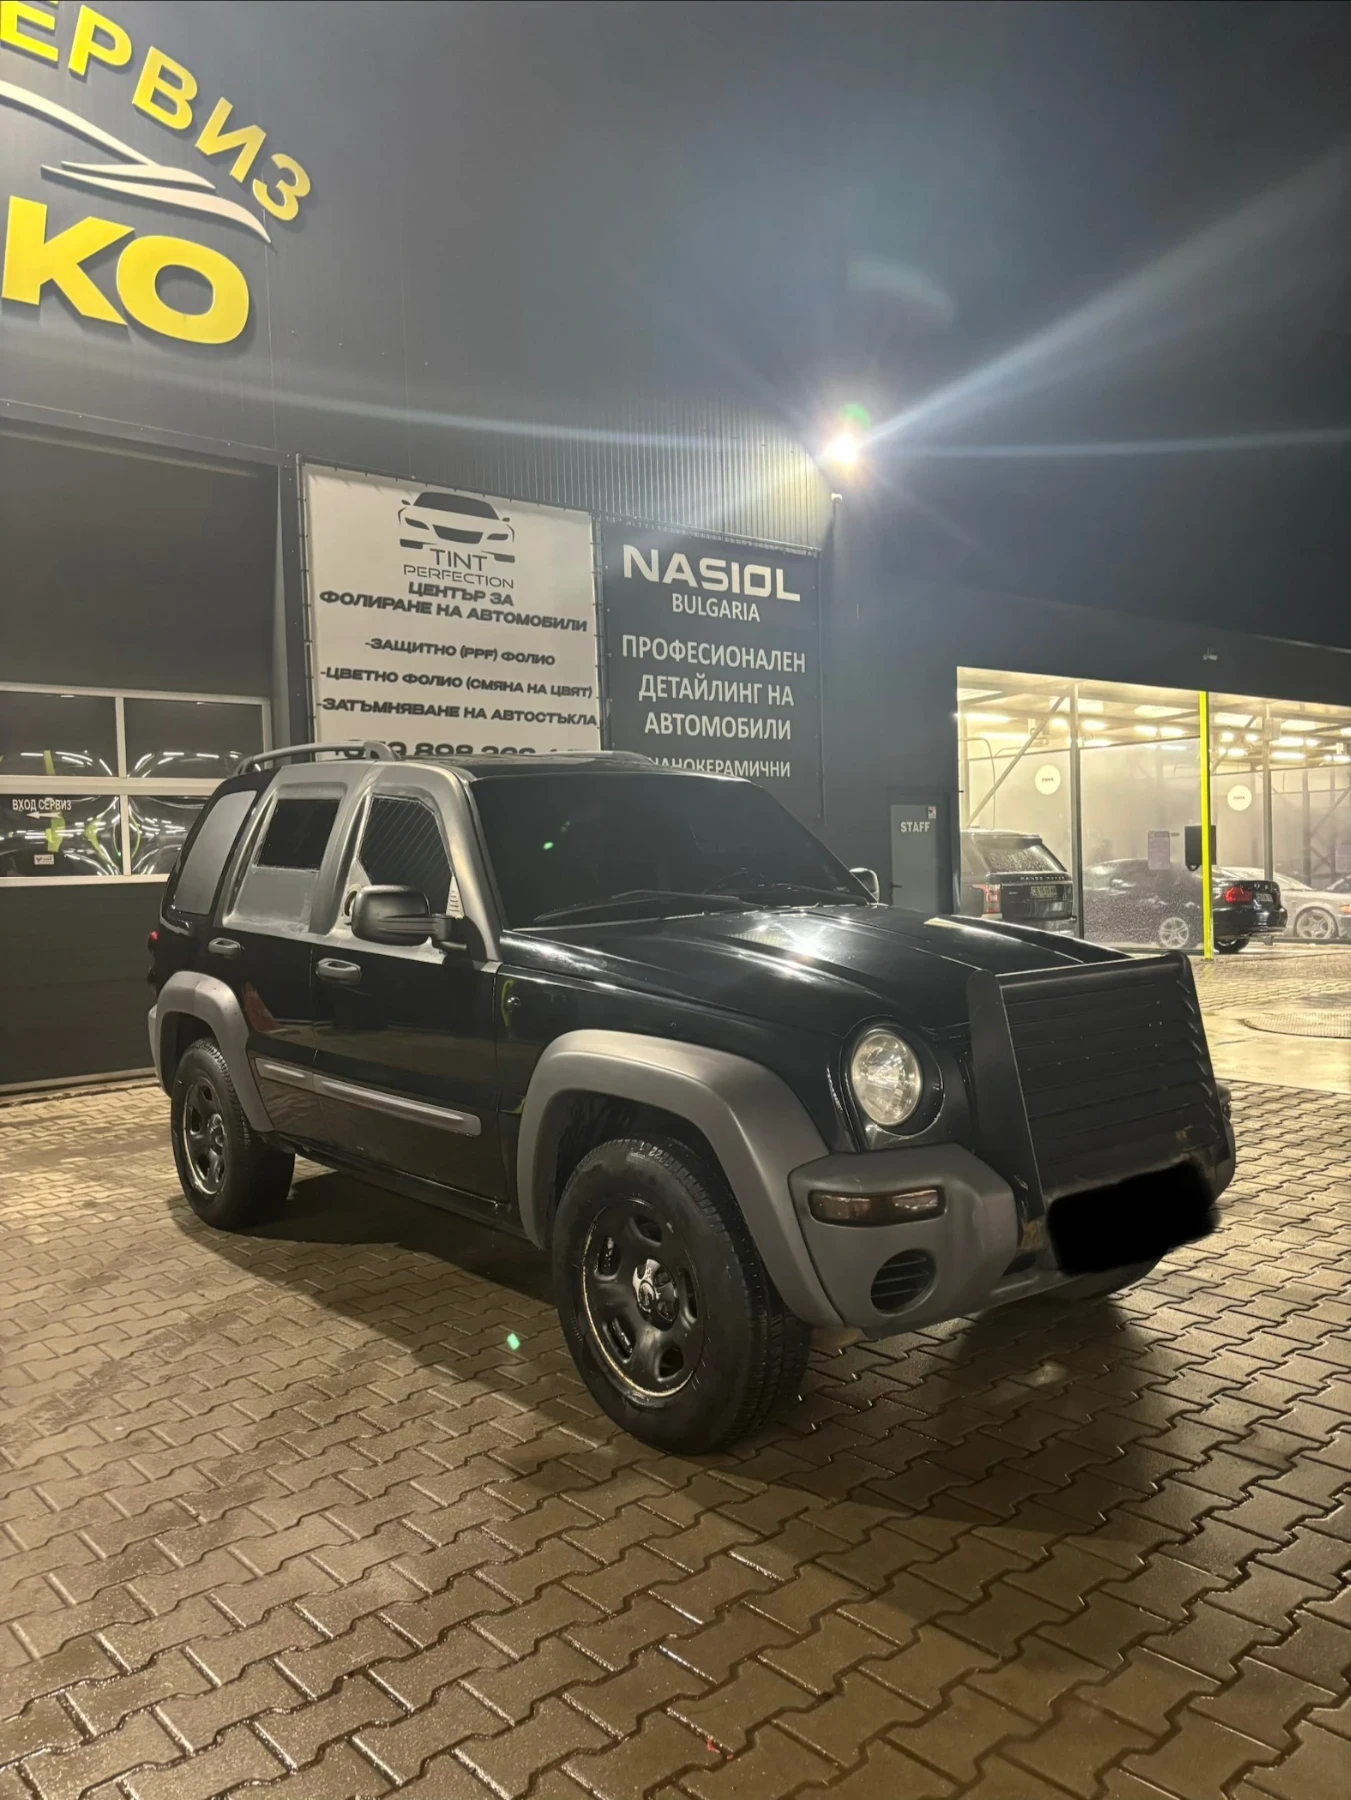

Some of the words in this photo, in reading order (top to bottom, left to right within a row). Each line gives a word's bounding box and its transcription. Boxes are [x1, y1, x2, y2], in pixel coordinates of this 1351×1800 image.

[1, 195, 250, 345] КО
[429, 548, 488, 572] TINT
[623, 544, 801, 602] NASIOL
[403, 564, 514, 589] PERFECTION
[408, 581, 486, 602] ЦЕНТЪР
[490, 591, 514, 607] ЗА
[319, 590, 433, 614] ФОЛИРАНЕ
[436, 602, 463, 618] НА
[466, 607, 588, 632] АВТОМОБИЛИ
[672, 593, 760, 622] BULGARIA
[460, 645, 498, 662] (PPF)
[501, 651, 555, 665] ФОЛИО
[622, 634, 806, 673] ПРОФЕСИОНАЛЕН
[402, 673, 463, 688] ФОЛИО
[466, 676, 524, 694] (СМЯНА
[527, 683, 547, 695] НА
[550, 685, 593, 699] ЦВЯТ)
[639, 673, 763, 704] ДЕТАЙЛИНГ
[768, 684, 795, 706] НА
[463, 706, 487, 719] НА
[490, 708, 597, 726] АВТОСТЪКЛА
[645, 712, 791, 740] АВТОМОБИЛИ
[12, 799, 37, 812] ВХОД
[38, 799, 72, 811] СЕРВИЗ
[900, 821, 930, 833] STAFF
